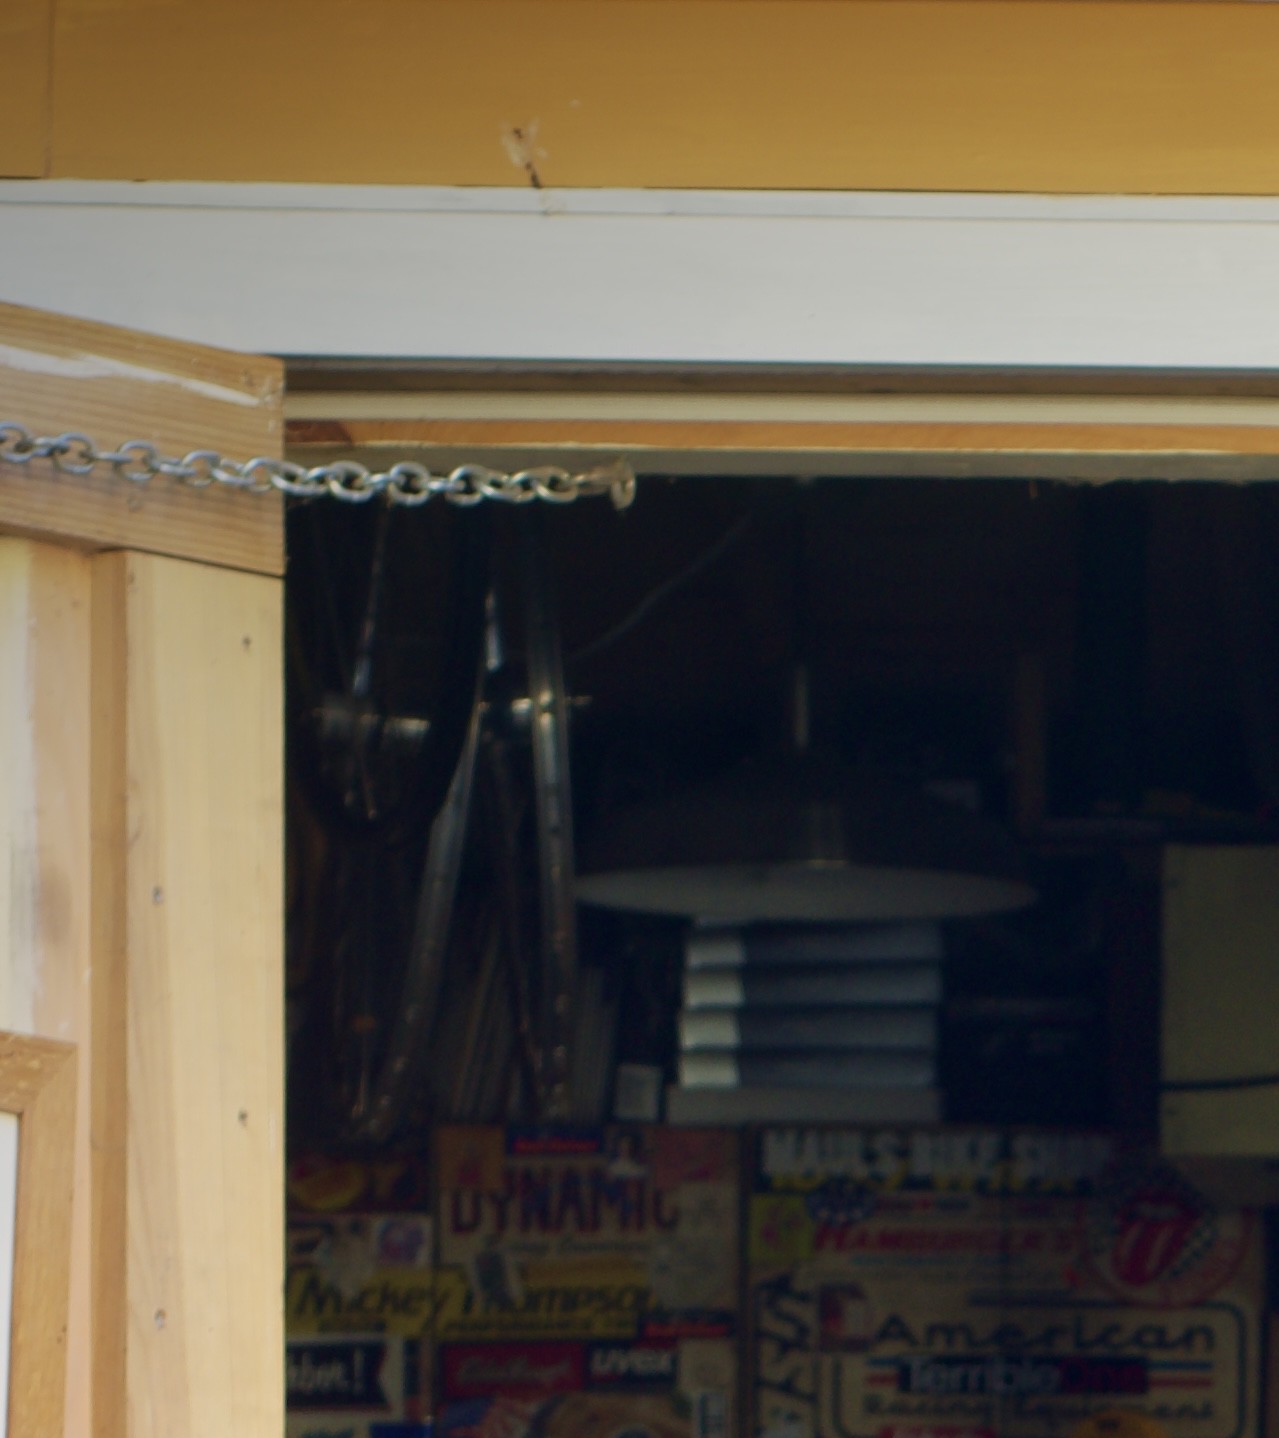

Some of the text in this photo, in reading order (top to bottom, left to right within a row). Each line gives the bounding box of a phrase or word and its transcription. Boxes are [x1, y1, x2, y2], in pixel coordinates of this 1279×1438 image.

[294, 1268, 655, 1330] Mickey Thompso
[873, 1313, 1216, 1352] American
[1014, 1395, 1214, 1427] Equient
